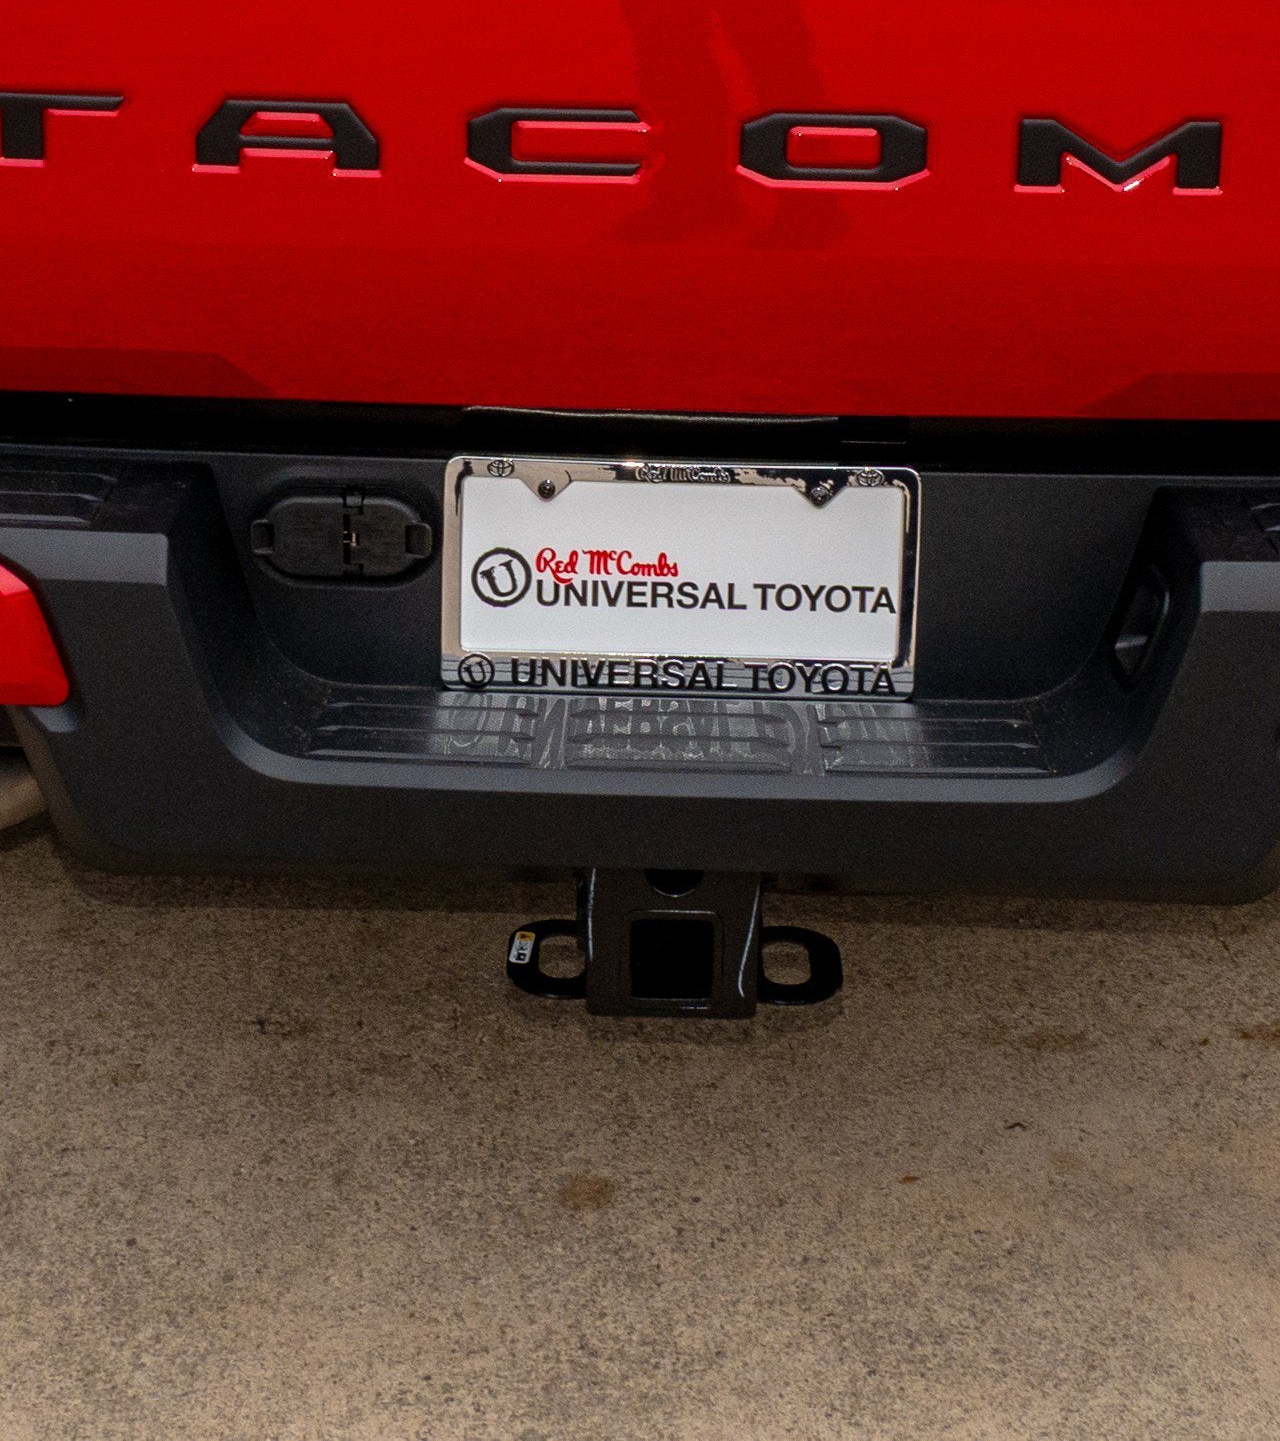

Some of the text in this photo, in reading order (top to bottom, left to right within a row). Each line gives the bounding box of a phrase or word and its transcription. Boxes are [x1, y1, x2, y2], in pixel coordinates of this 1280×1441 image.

[535, 546, 680, 585] Red McCombs
[536, 578, 897, 615] UNIVERSAL TOYOTA
[510, 655, 739, 691] UNIVERSAL
[743, 661, 897, 696] TOYOTA
